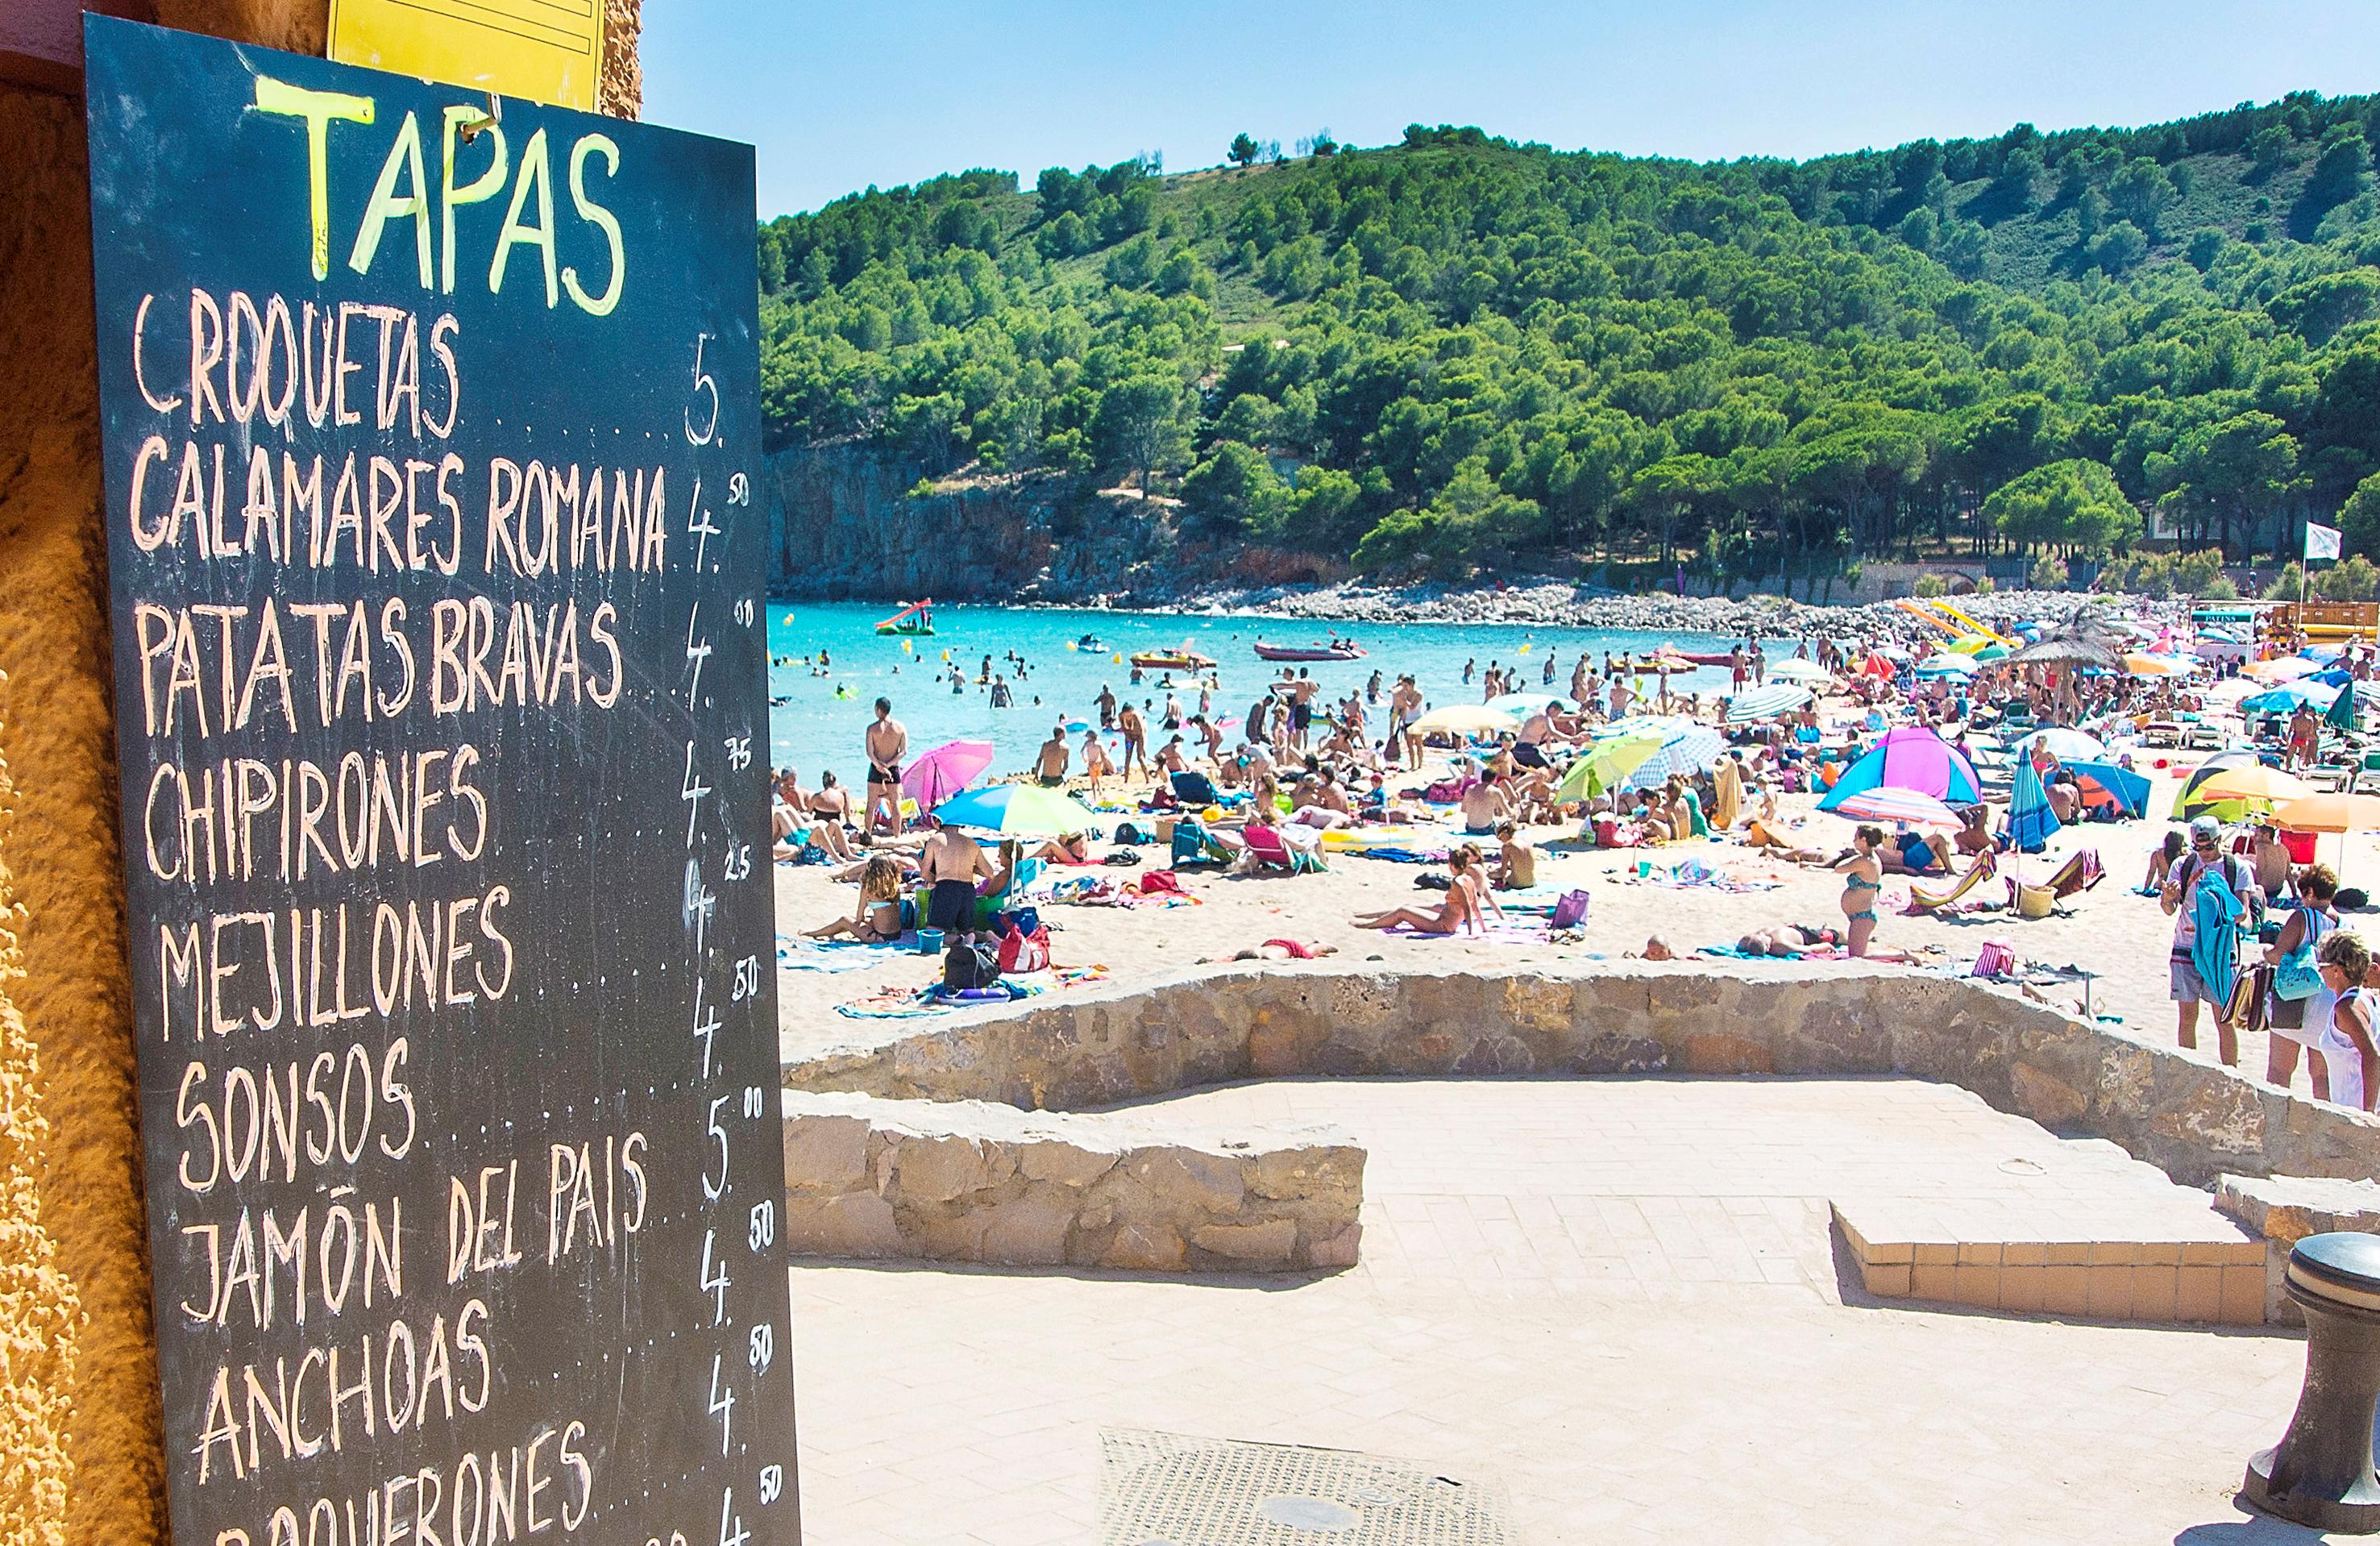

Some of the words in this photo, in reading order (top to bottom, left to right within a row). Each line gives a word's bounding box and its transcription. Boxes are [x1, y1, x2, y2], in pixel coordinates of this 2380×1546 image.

[255, 74, 625, 317] TAPAS
[133, 288, 460, 441] CROQUETAS
[131, 435, 464, 576] CALAMARES
[485, 457, 667, 579] ROMANA
[135, 596, 414, 738] PATATAS
[431, 595, 623, 717] BRAVAS
[145, 743, 487, 883] CHIPIRONES
[160, 884, 513, 1041] MEJILLONES
[177, 1036, 416, 1193] SONSOS
[447, 1160, 522, 1284] DEL
[549, 1131, 648, 1265] PAIS
[192, 1299, 489, 1486] ANCHOAS
